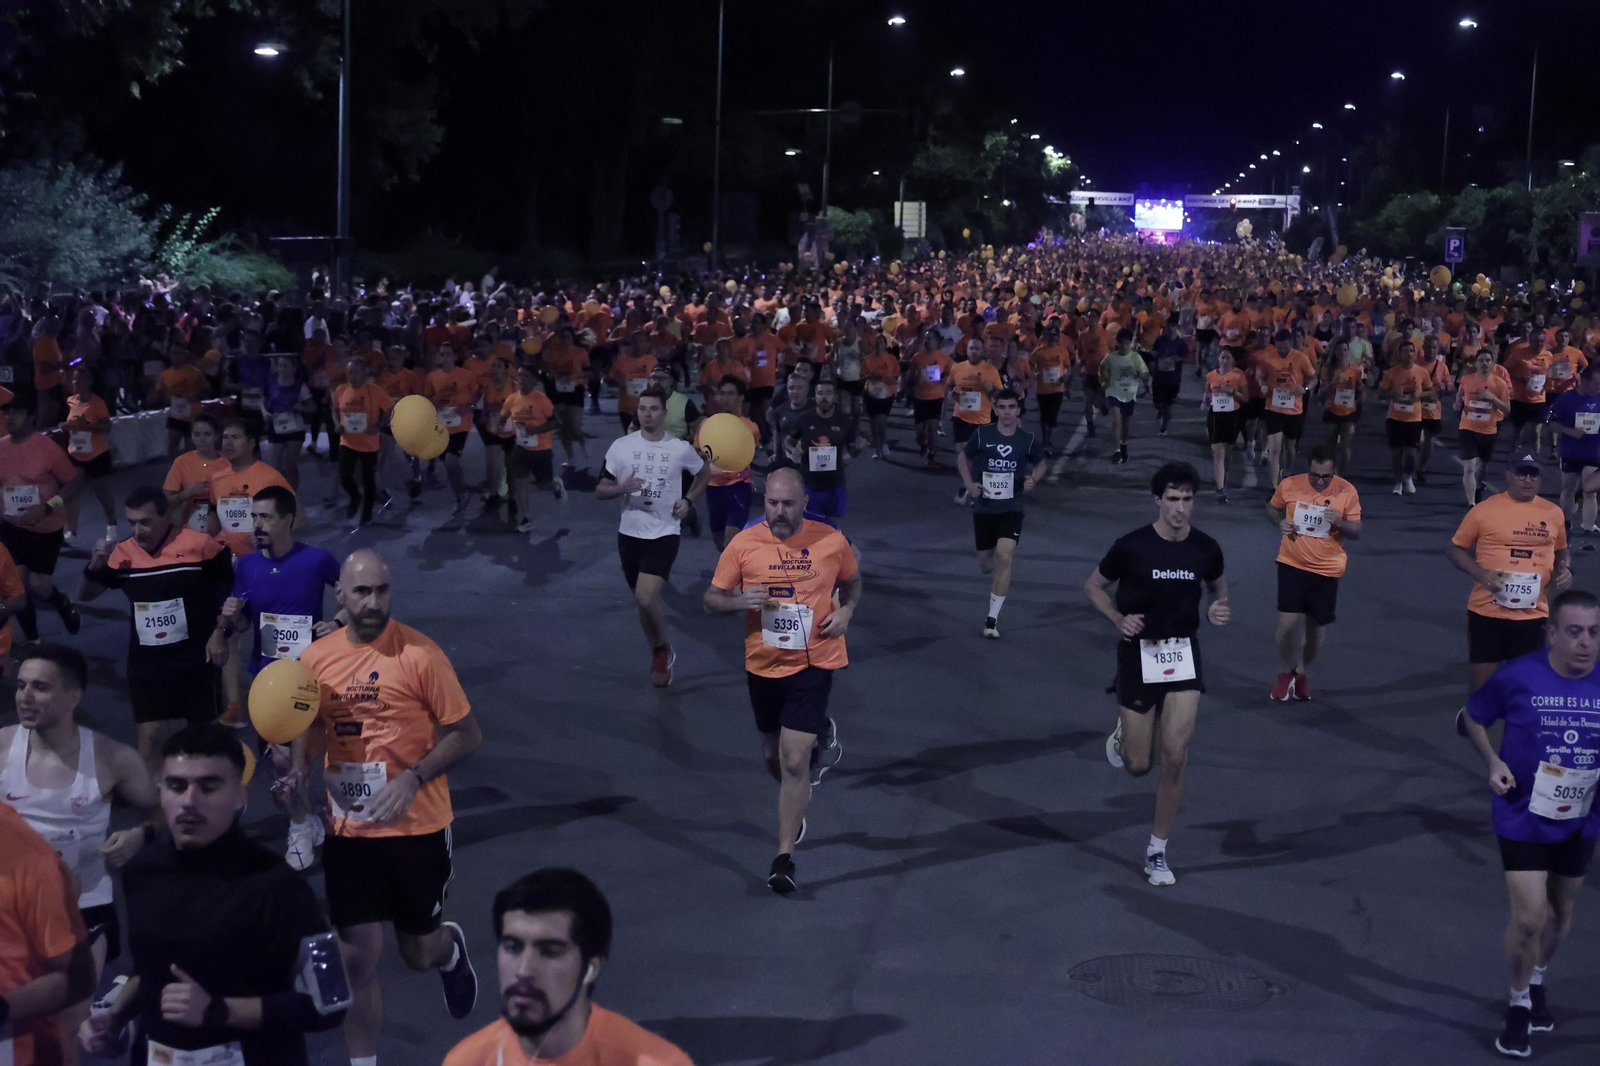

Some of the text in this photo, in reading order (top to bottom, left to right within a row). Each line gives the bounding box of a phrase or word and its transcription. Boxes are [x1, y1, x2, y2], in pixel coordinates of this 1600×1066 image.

[1449, 239, 1460, 250] P
[988, 458, 1018, 469] sano
[989, 481, 1009, 489] 18252
[225, 509, 248, 519] 10696
[1303, 513, 1323, 525] 9119
[1505, 583, 1532, 595] 17755
[145, 614, 177, 628] 21580
[774, 618, 799, 631] 5336
[273, 628, 299, 641] 3500
[1154, 651, 1183, 664] 18376
[345, 685, 380, 693] NOCTURNA
[330, 693, 359, 701] SEVILLA
[1531, 695, 1565, 707] CORRER
[1567, 696, 1578, 708] ES
[1580, 697, 1591, 708] LA
[1559, 716, 1568, 726] de
[1568, 716, 1580, 727] San
[1546, 745, 1599, 755] Sevilla Wagen
[340, 781, 371, 797] 3890
[1553, 784, 1585, 799] 5035
